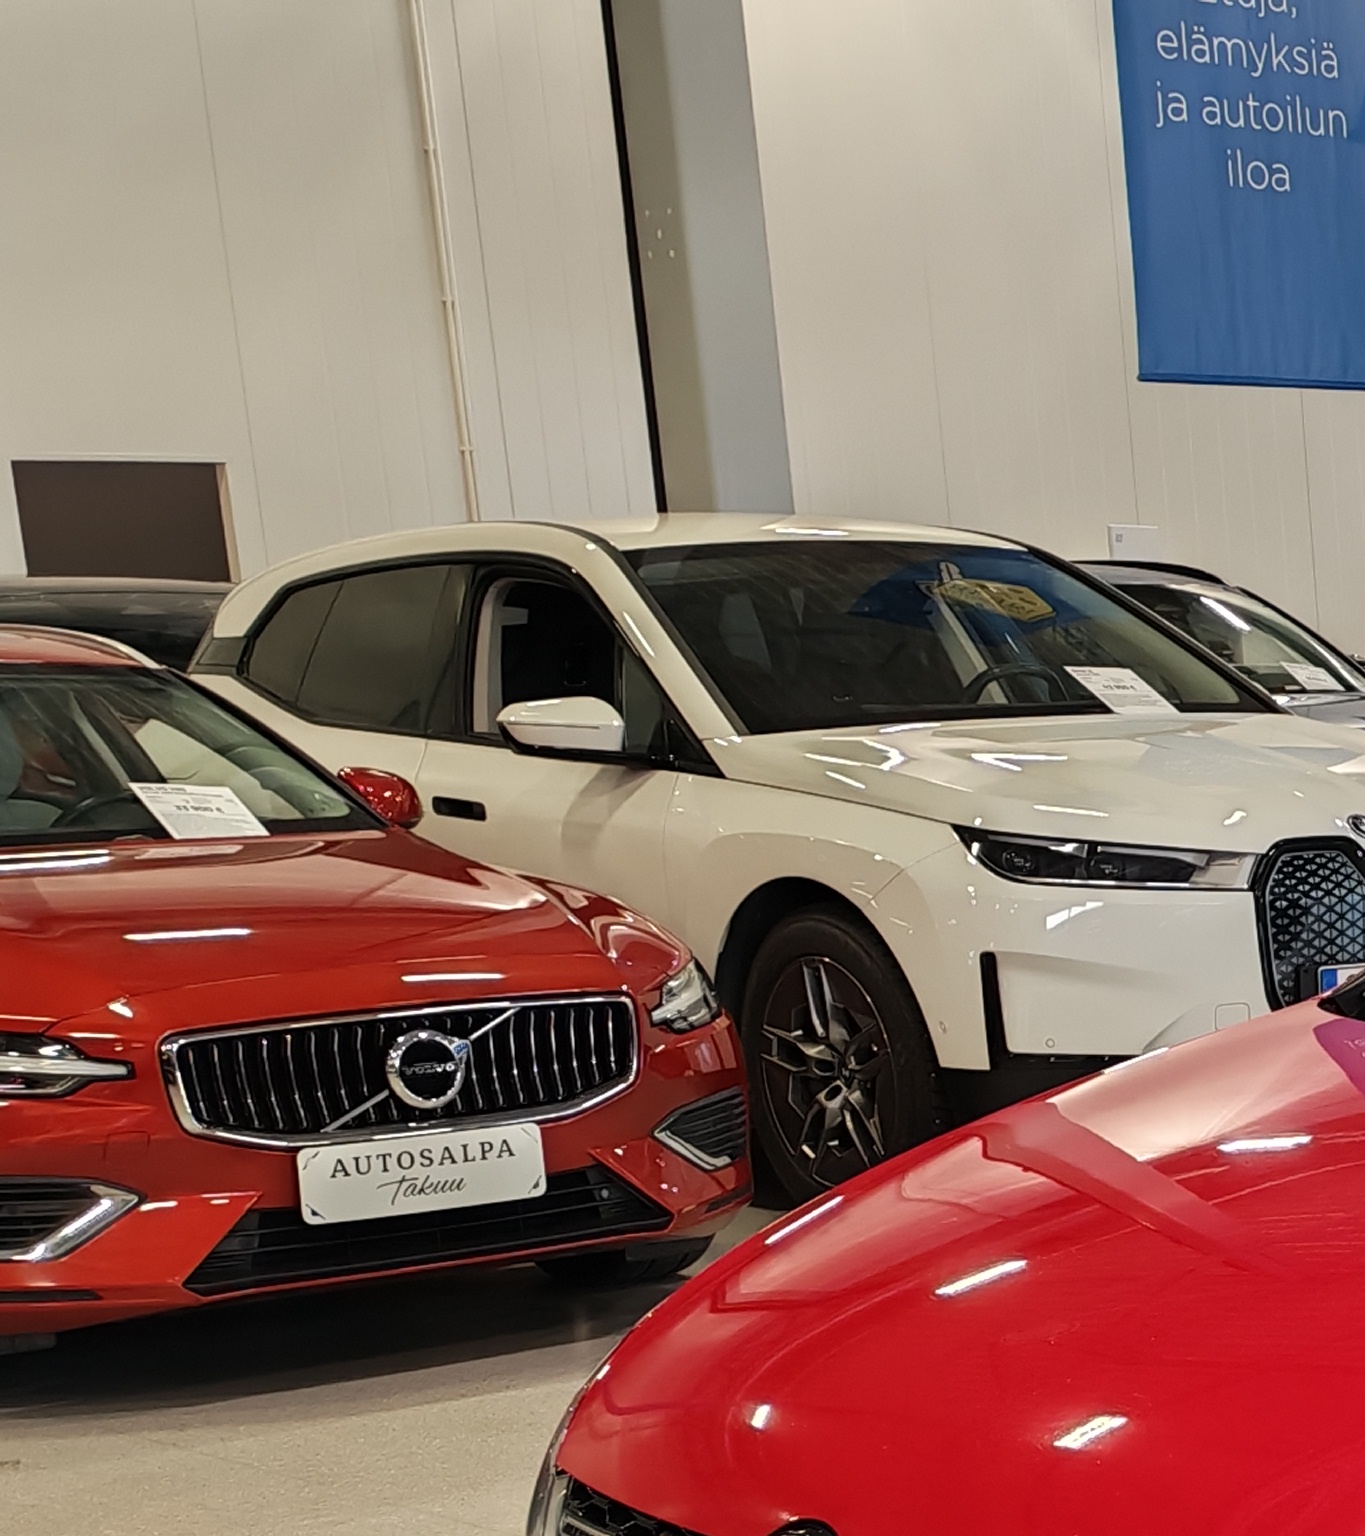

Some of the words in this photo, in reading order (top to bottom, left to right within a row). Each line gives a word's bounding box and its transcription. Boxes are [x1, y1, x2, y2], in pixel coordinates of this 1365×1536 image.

[1156, 20, 1339, 78] elämyksiä
[1156, 80, 1188, 128] ja
[1201, 93, 1348, 139] autoilun
[1226, 149, 1291, 192] iloa
[330, 1139, 516, 1178] AUTOSALPA
[376, 1174, 467, 1206] Takuu
